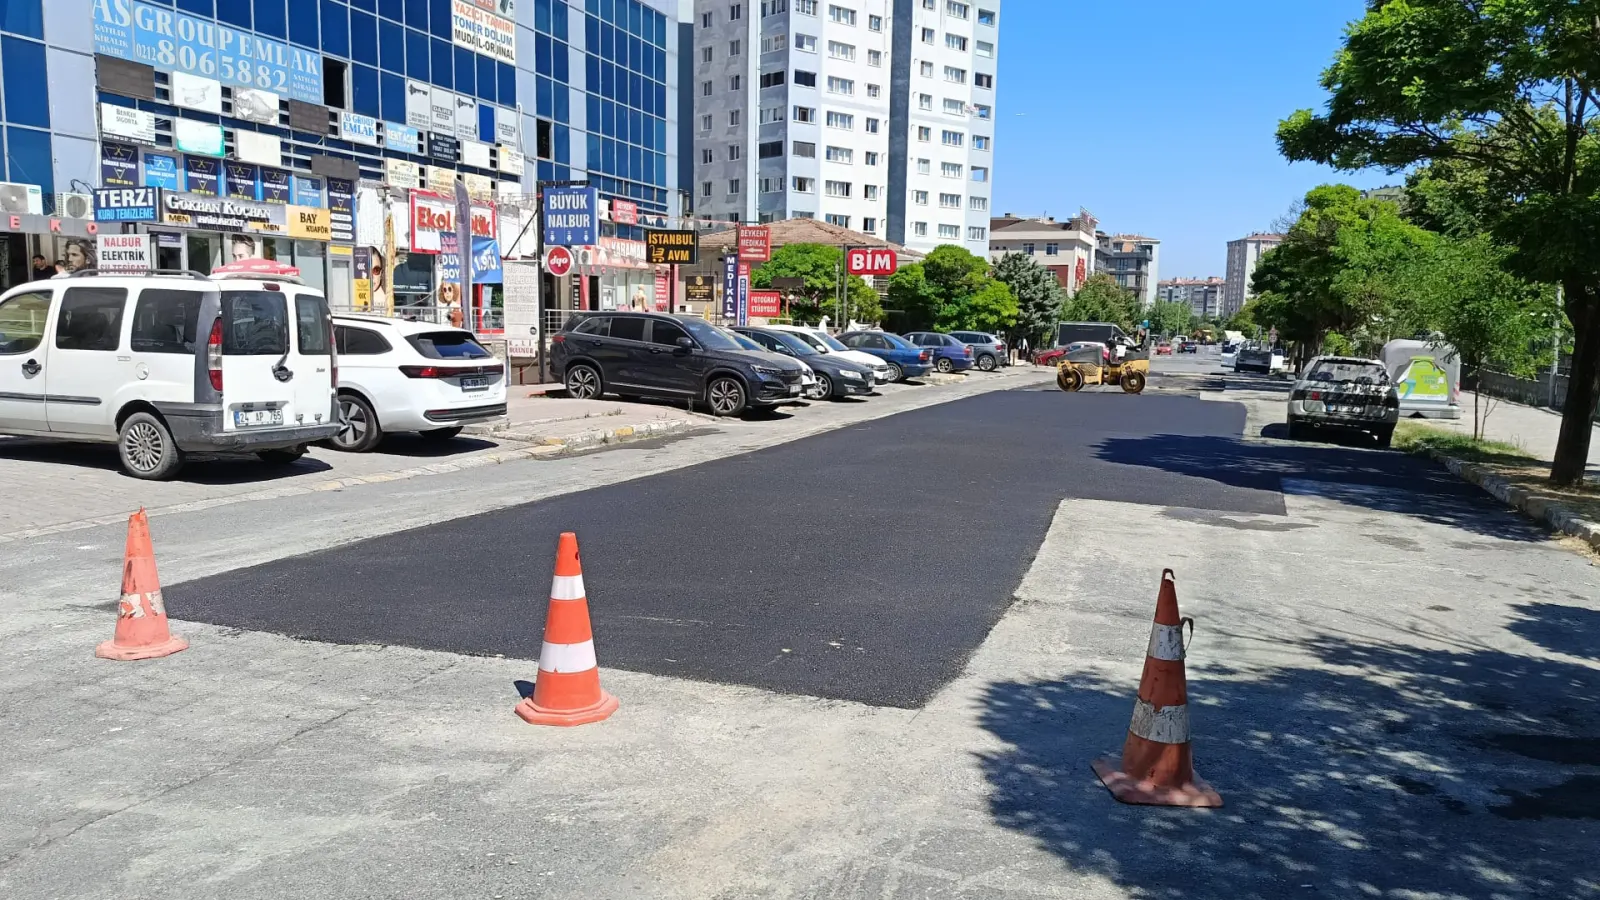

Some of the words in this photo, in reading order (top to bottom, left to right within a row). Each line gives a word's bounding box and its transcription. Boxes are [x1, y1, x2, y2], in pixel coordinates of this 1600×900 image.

[453, 15, 483, 35] TONER
[484, 27, 513, 47] DOLUM
[135, 5, 233, 52] GROUP
[239, 34, 319, 76] EMLAK
[157, 39, 288, 93] 8065882
[343, 121, 375, 137] EMLAK
[549, 191, 588, 209] BÜYÜK
[97, 209, 115, 220] KURU
[168, 214, 189, 223] MEN
[300, 212, 318, 224] BAY
[547, 213, 590, 228] NALBUR
[263, 223, 280, 231] MEN
[740, 229, 768, 237] BEYKENT
[103, 237, 141, 247] NALBUR
[648, 231, 694, 245] İSTANBUL
[102, 249, 145, 261] ELEKTRİK
[667, 250, 689, 261] AVM
[851, 248, 891, 270] BİM
[751, 295, 777, 304] FOTOĞRAF
[239, 412, 249, 423] 24
[255, 412, 264, 421] AP
[270, 410, 282, 421] 765
